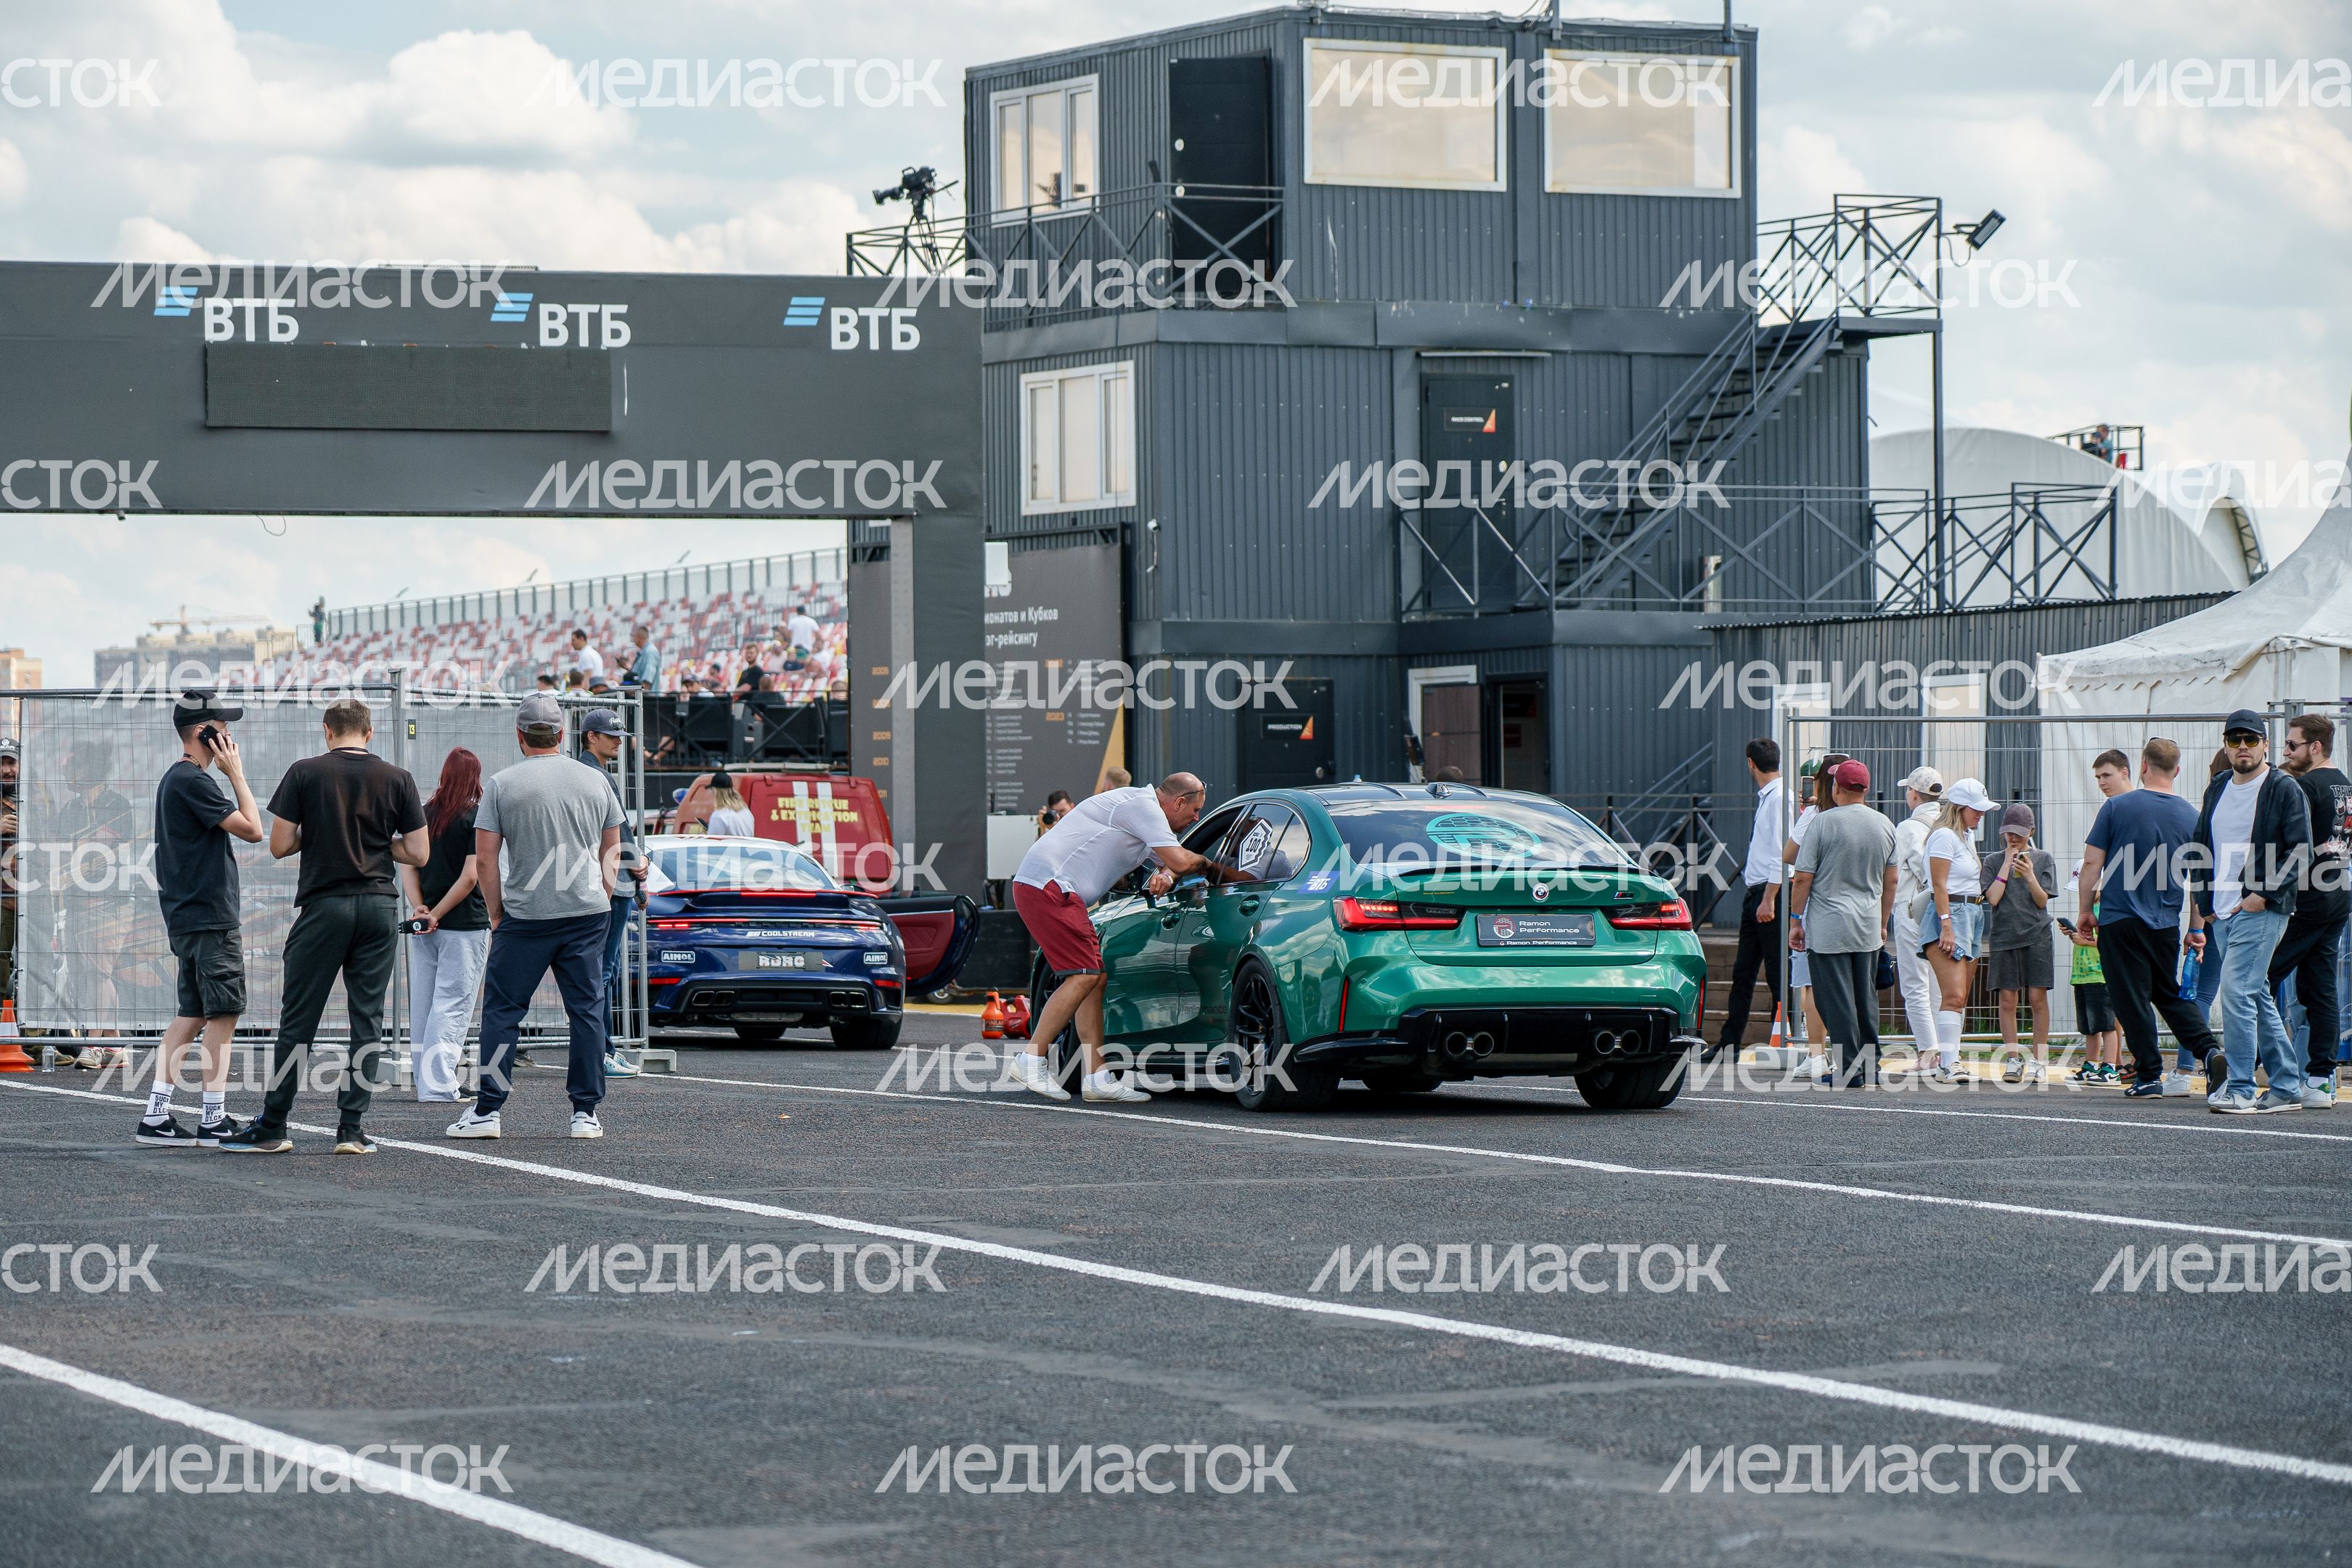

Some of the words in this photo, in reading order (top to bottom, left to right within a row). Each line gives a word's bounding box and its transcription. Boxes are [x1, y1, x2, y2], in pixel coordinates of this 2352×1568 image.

[204, 298, 299, 343] ВТБ
[539, 304, 631, 348] ВТБ
[831, 307, 920, 351] ВТБ
[1020, 611, 1026, 623] и
[1028, 605, 1058, 625] Кубков
[778, 797, 804, 809] FIRE
[807, 797, 849, 810] RESCUE
[801, 822, 831, 833] TEAM
[1245, 837, 1262, 853] 100
[1308, 878, 1331, 891] ВТБ
